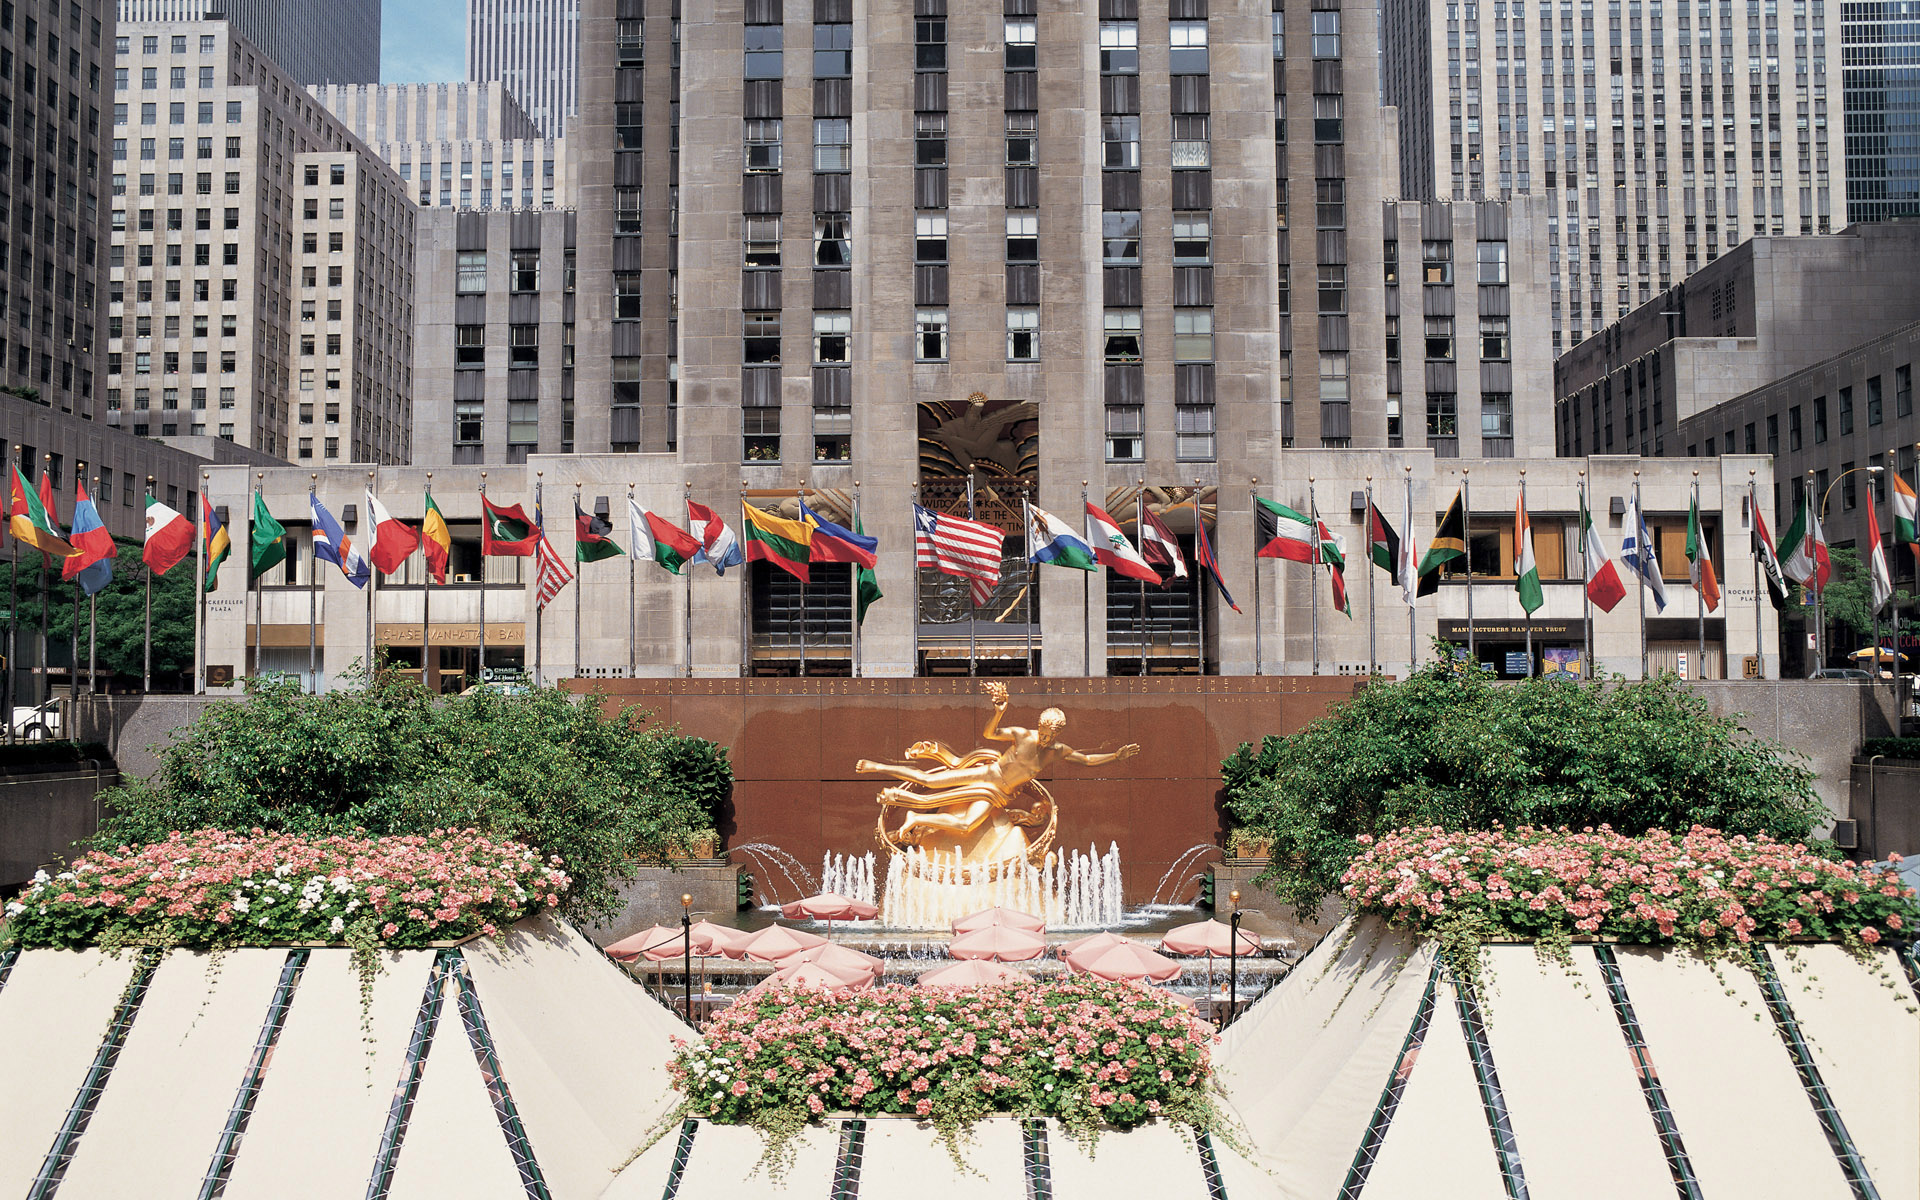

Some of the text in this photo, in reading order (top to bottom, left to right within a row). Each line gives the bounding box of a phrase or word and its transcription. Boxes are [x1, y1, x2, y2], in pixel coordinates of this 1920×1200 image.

[921, 499, 956, 508] WISDO
[980, 511, 991, 519] BE
[993, 511, 1007, 519] THE
[1007, 522, 1025, 532] TIM
[383, 629, 421, 641] CHASE
[499, 628, 524, 641] BAN
[33, 667, 65, 675] INFMATION
